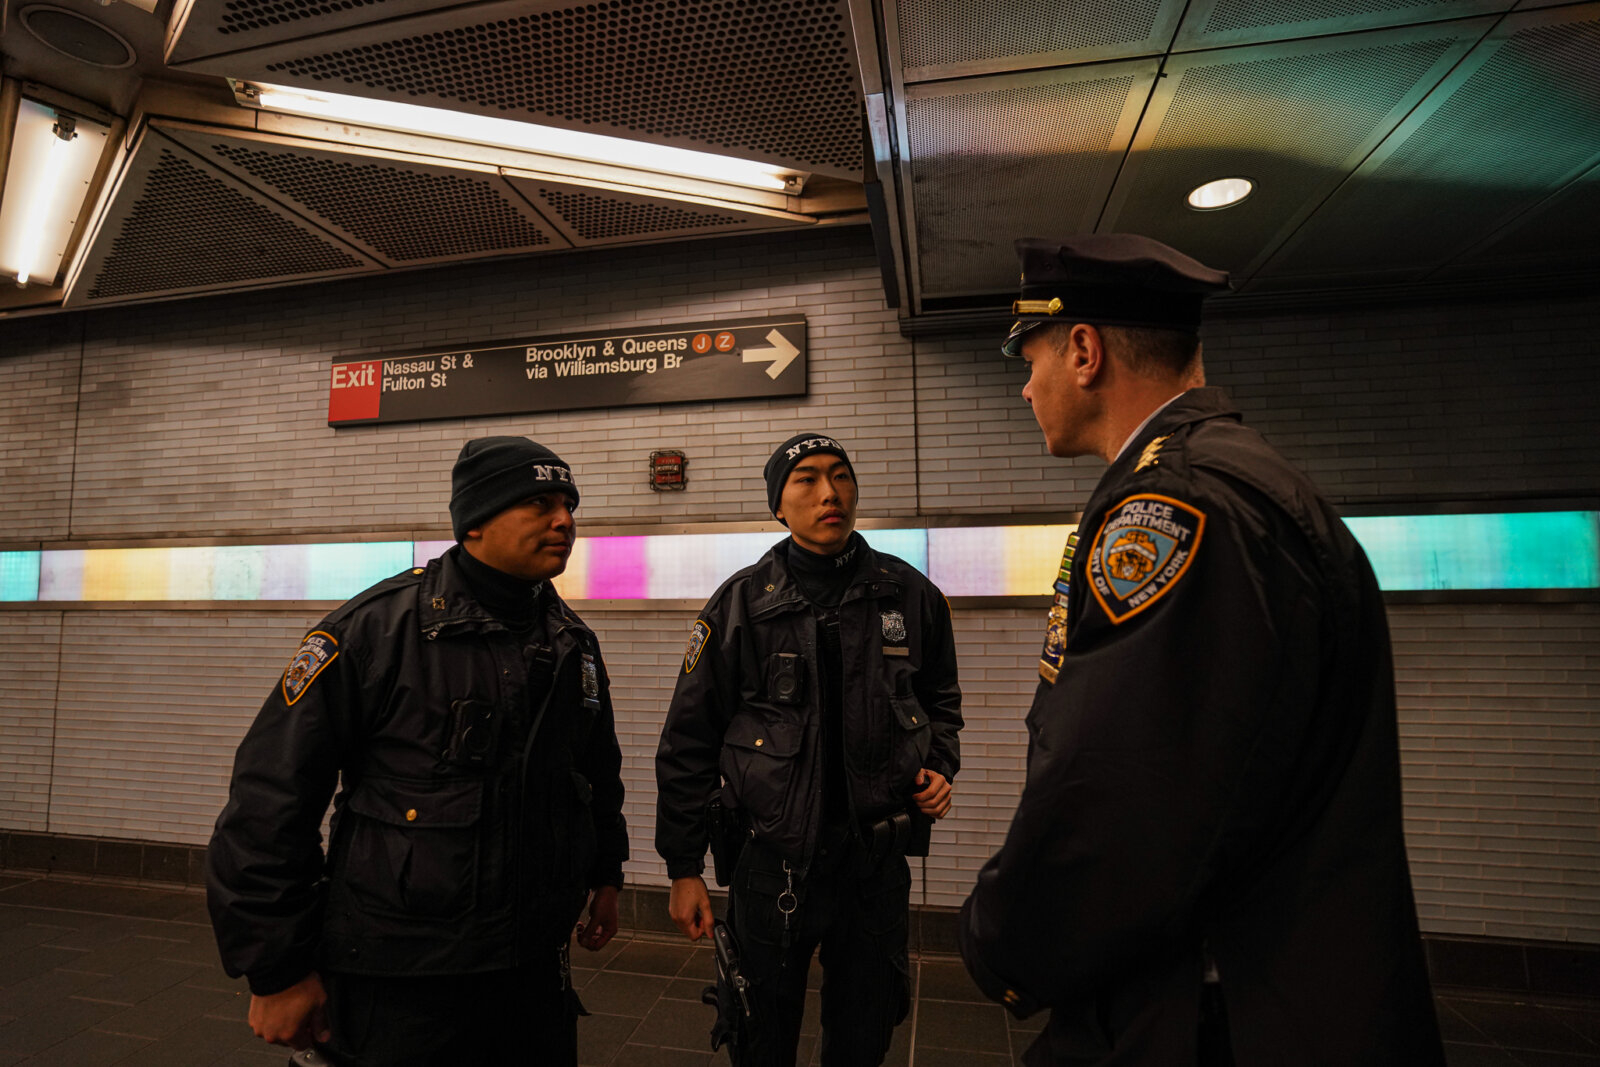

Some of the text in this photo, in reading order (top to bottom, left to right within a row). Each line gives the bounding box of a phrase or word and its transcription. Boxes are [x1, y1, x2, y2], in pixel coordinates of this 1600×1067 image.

[525, 344, 597, 363] Brooklyn
[602, 340, 615, 356] &
[621, 338, 688, 354] Queens
[331, 364, 375, 389] Exit
[383, 353, 474, 376] Nassau St &
[525, 353, 683, 380] via Williamsburg Br
[382, 373, 447, 392] Fulton St
[1121, 501, 1174, 518] POLICE
[1103, 513, 1191, 542] DEPARTMENT
[1095, 577, 1111, 597] OF
[1127, 550, 1189, 608] NEW YORK
